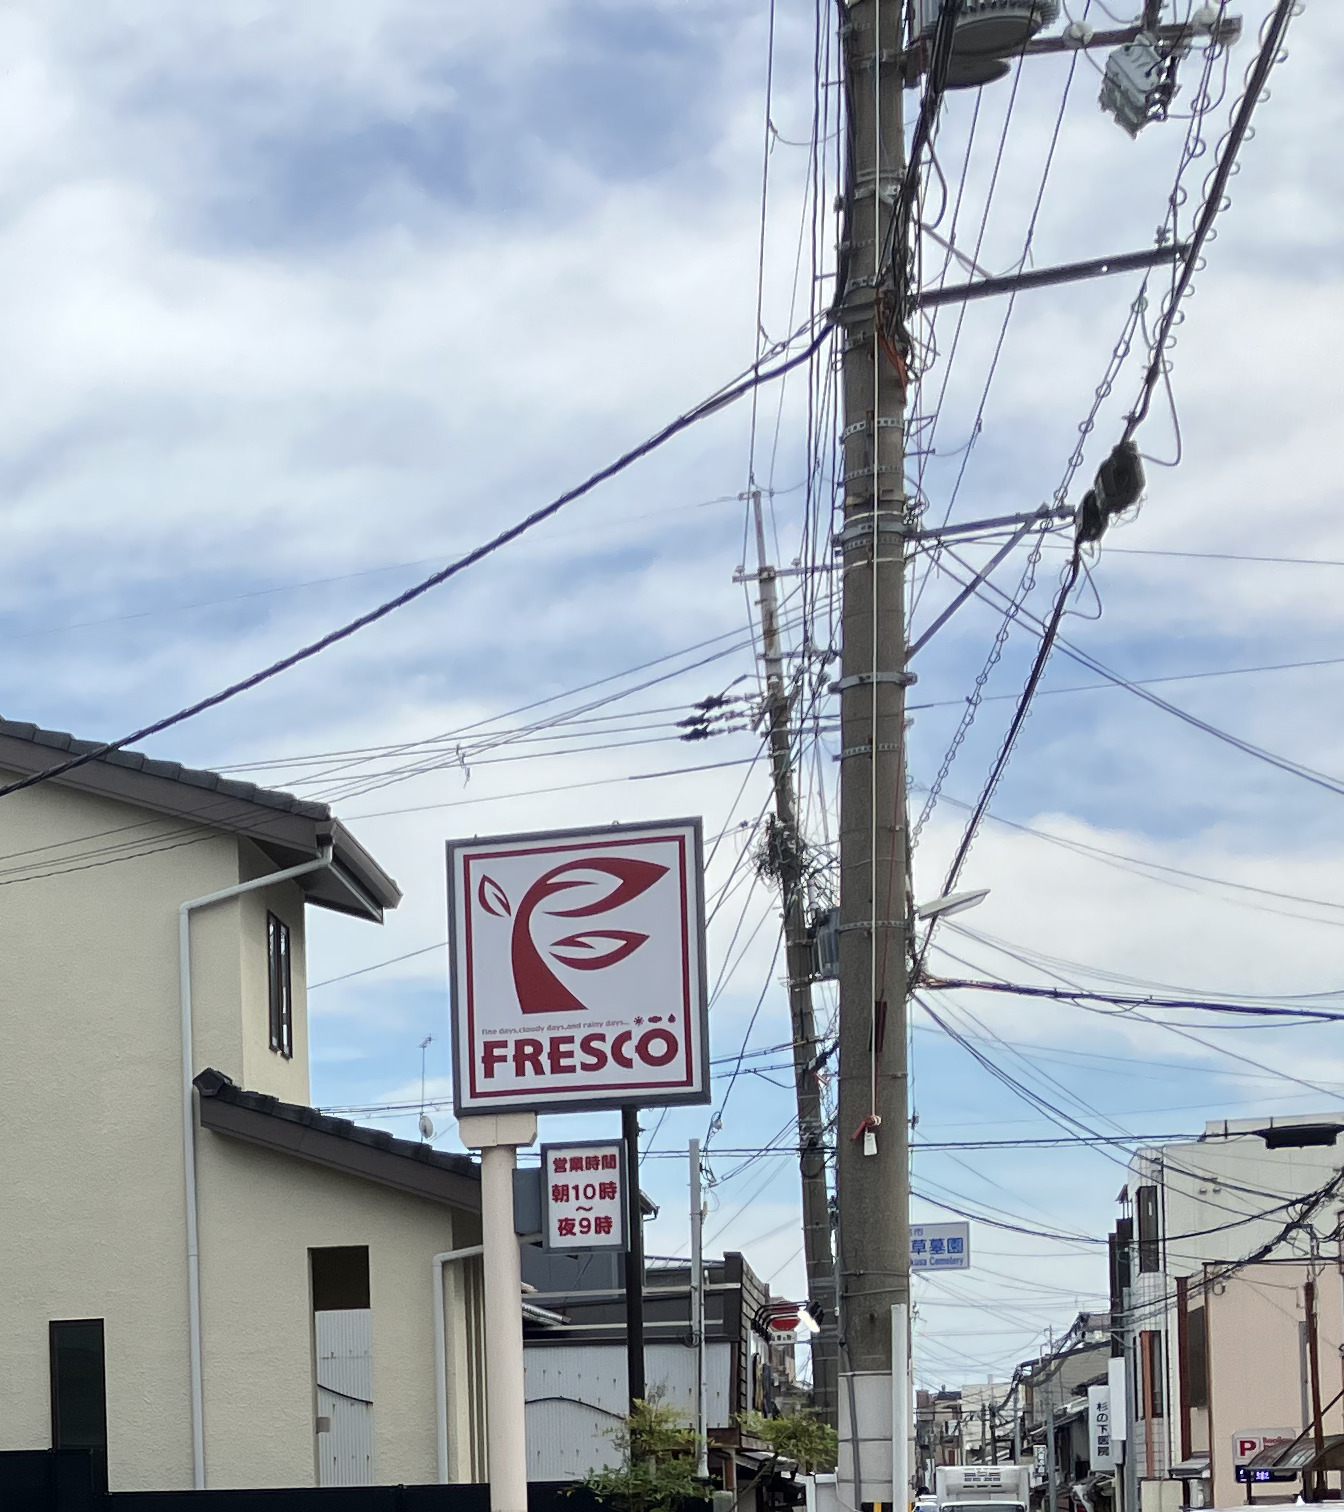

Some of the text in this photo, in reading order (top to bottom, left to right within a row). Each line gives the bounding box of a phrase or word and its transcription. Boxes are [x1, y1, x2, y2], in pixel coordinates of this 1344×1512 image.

[481, 1028, 679, 1079] FRESCO
[553, 1154, 616, 1173] 営業時間
[552, 1181, 617, 1203] 朝10時
[558, 1215, 613, 1236] 夜9時
[1240, 1440, 1256, 1456] P
